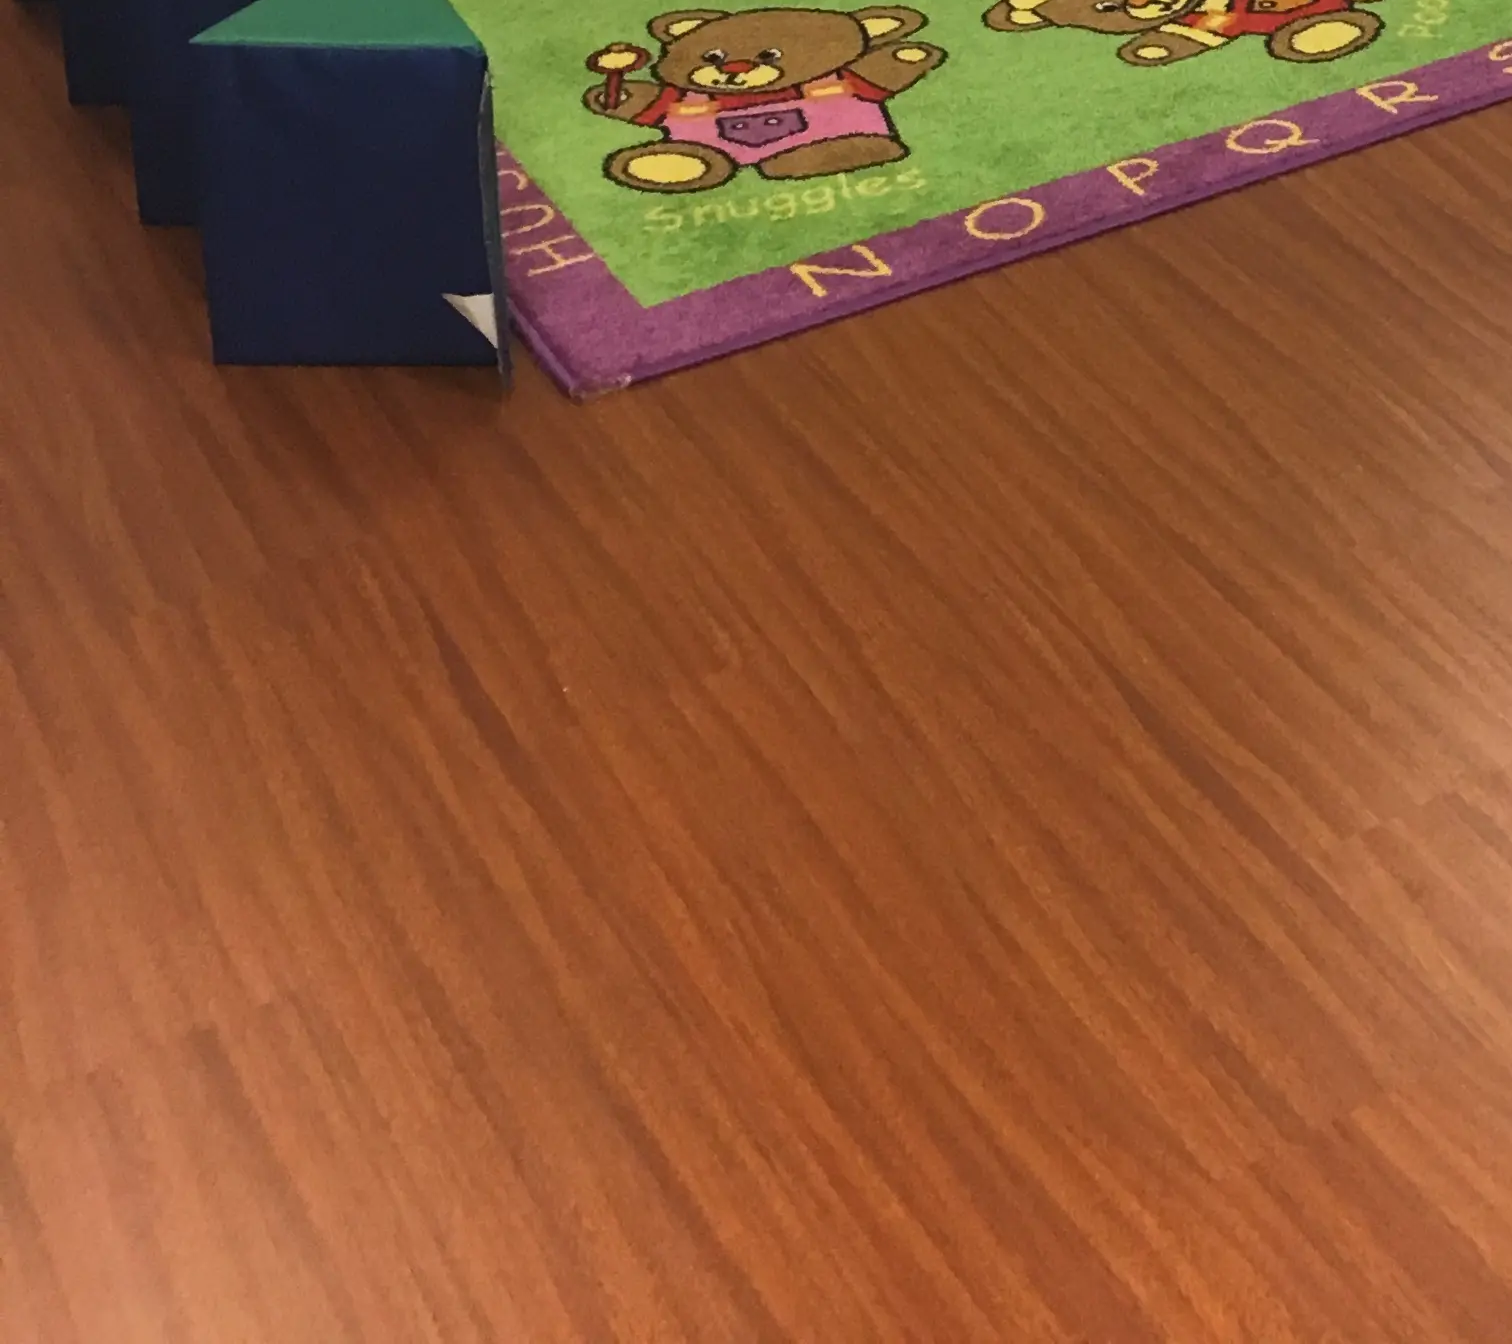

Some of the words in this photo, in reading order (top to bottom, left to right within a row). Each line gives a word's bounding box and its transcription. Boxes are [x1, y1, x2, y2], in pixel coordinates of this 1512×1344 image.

[643, 165, 928, 234] Snuggles
[791, 244, 892, 298] N
[964, 197, 1045, 241] O
[1108, 158, 1159, 196] P
[1226, 119, 1319, 155] Q
[1356, 80, 1438, 114] R
